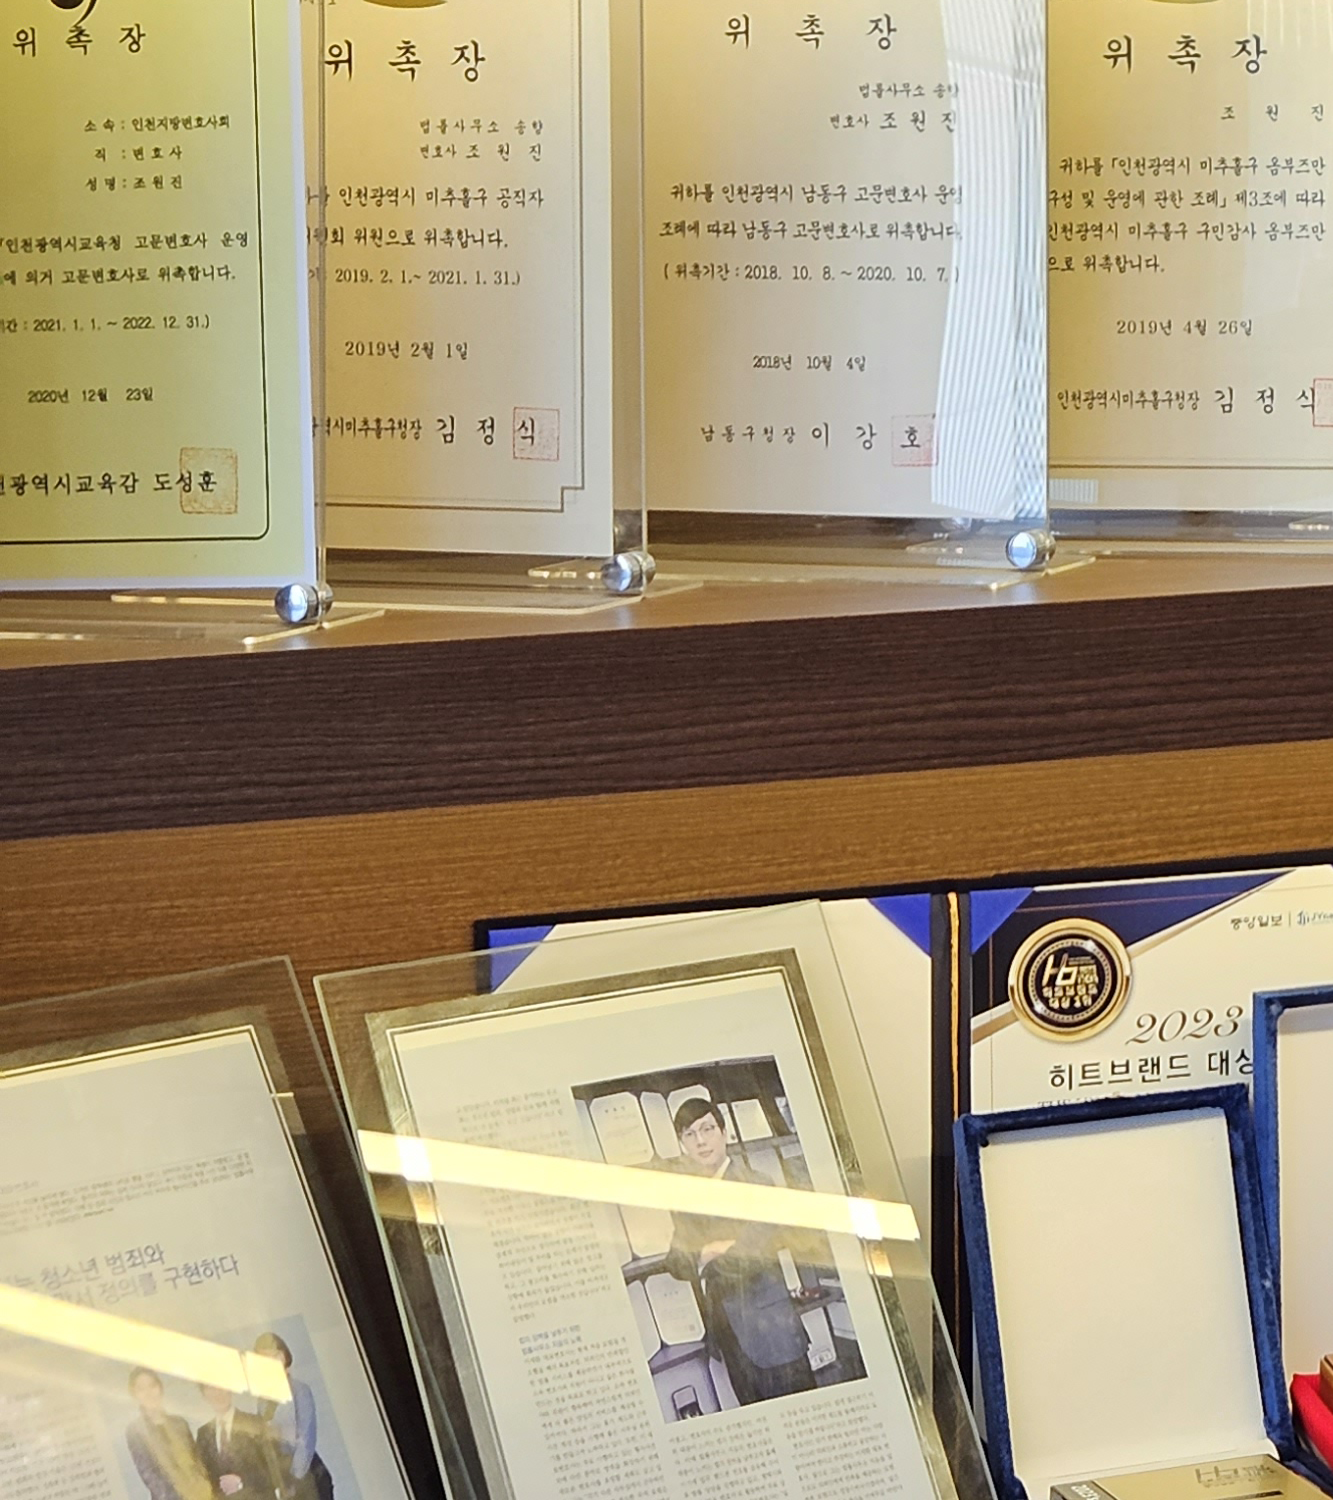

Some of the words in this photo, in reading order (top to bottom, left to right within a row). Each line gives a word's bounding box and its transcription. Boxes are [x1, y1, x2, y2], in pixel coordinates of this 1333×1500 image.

[132, 114, 230, 132] 인천지방변호사회
[830, 113, 869, 129] 변호사
[420, 145, 457, 159] 변호사
[1060, 158, 1103, 177] 귀하를
[1200, 156, 1258, 176] 미추홀구
[1266, 156, 1326, 176] 옴부즈만
[339, 186, 415, 208] 인천광역시
[426, 187, 487, 208] 미추홀구
[497, 187, 543, 209] 공직자
[672, 185, 714, 204] 귀하를
[722, 184, 793, 204] 인천광역시
[801, 184, 847, 205] 남동구
[854, 185, 927, 204] 고문변호사
[1082, 191, 1095, 209] 및
[1104, 190, 1145, 209] 운영에
[1154, 190, 1183, 208] 관한
[1235, 190, 1287, 208] 제3조에
[1297, 189, 1326, 208] 따라
[135, 233, 207, 249] 고문변호사
[221, 232, 248, 248] 운영
[353, 227, 416, 247] 위원으로
[424, 227, 508, 249] 위촉합니다.
[660, 222, 700, 238] 조례에
[707, 222, 736, 237] 따라
[744, 222, 788, 240] 남동구
[793, 221, 880, 240] 고문변호사로
[1128, 222, 1188, 241] 미추홀구
[1197, 222, 1256, 241] 구민감사
[1265, 222, 1326, 241] 옴부즈만
[1083, 255, 1164, 274] 위촉합니다.
[26, 269, 52, 286] 의거
[62, 268, 148, 285] 고문변호사로
[158, 266, 235, 283] 위촉합니다.
[1117, 319, 1172, 336] 2019년
[1183, 319, 1206, 335] 4월
[1218, 319, 1252, 336] 26일
[345, 341, 400, 359] 2019년
[411, 341, 434, 359] 2월
[446, 341, 468, 360] 1일
[753, 355, 792, 372] 2018년
[807, 356, 832, 371] 10월
[847, 356, 866, 372] 4일
[28, 389, 69, 404] 2020년
[82, 388, 107, 402] 12월
[126, 387, 153, 402] 23일
[1057, 390, 1200, 411] 인천광역시미추홀구청장
[153, 471, 216, 493] 도성훈
[1126, 1005, 1243, 1046] 2023
[1050, 1053, 1190, 1092] 히트브랜드
[105, 1242, 165, 1276] 범죄와
[164, 1254, 239, 1290] 구현하다
